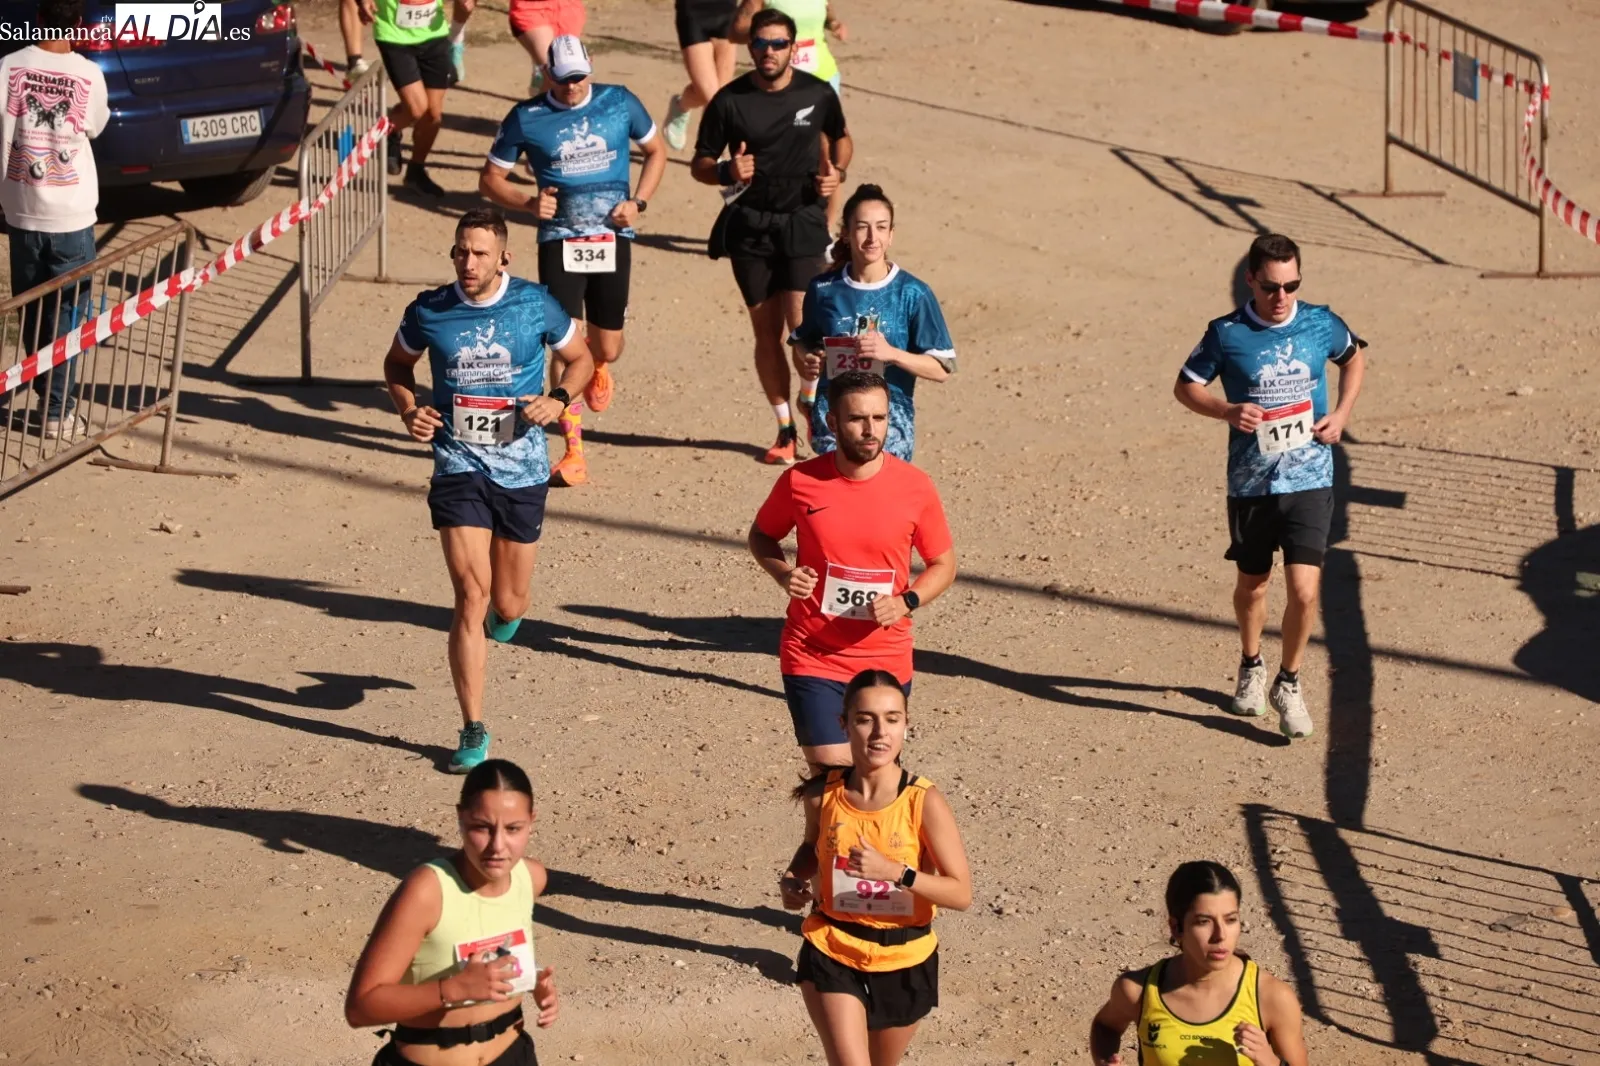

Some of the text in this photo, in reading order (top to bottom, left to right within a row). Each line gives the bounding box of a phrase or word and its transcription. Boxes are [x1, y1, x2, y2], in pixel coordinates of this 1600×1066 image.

[405, 9, 437, 20] 154
[26, 72, 76, 88] VALUABLE
[24, 83, 75, 98] PRESENCE
[191, 114, 258, 139] 4309 CRC
[573, 248, 606, 262] 334
[461, 361, 510, 369] IX Carrera
[1262, 377, 1309, 388] IX Carrera
[1249, 386, 1293, 396] Salamanca
[1259, 391, 1311, 402] Universitaria
[464, 414, 501, 433] 121
[1268, 420, 1305, 442] 171
[835, 587, 879, 607] 369
[856, 879, 890, 901] 92
